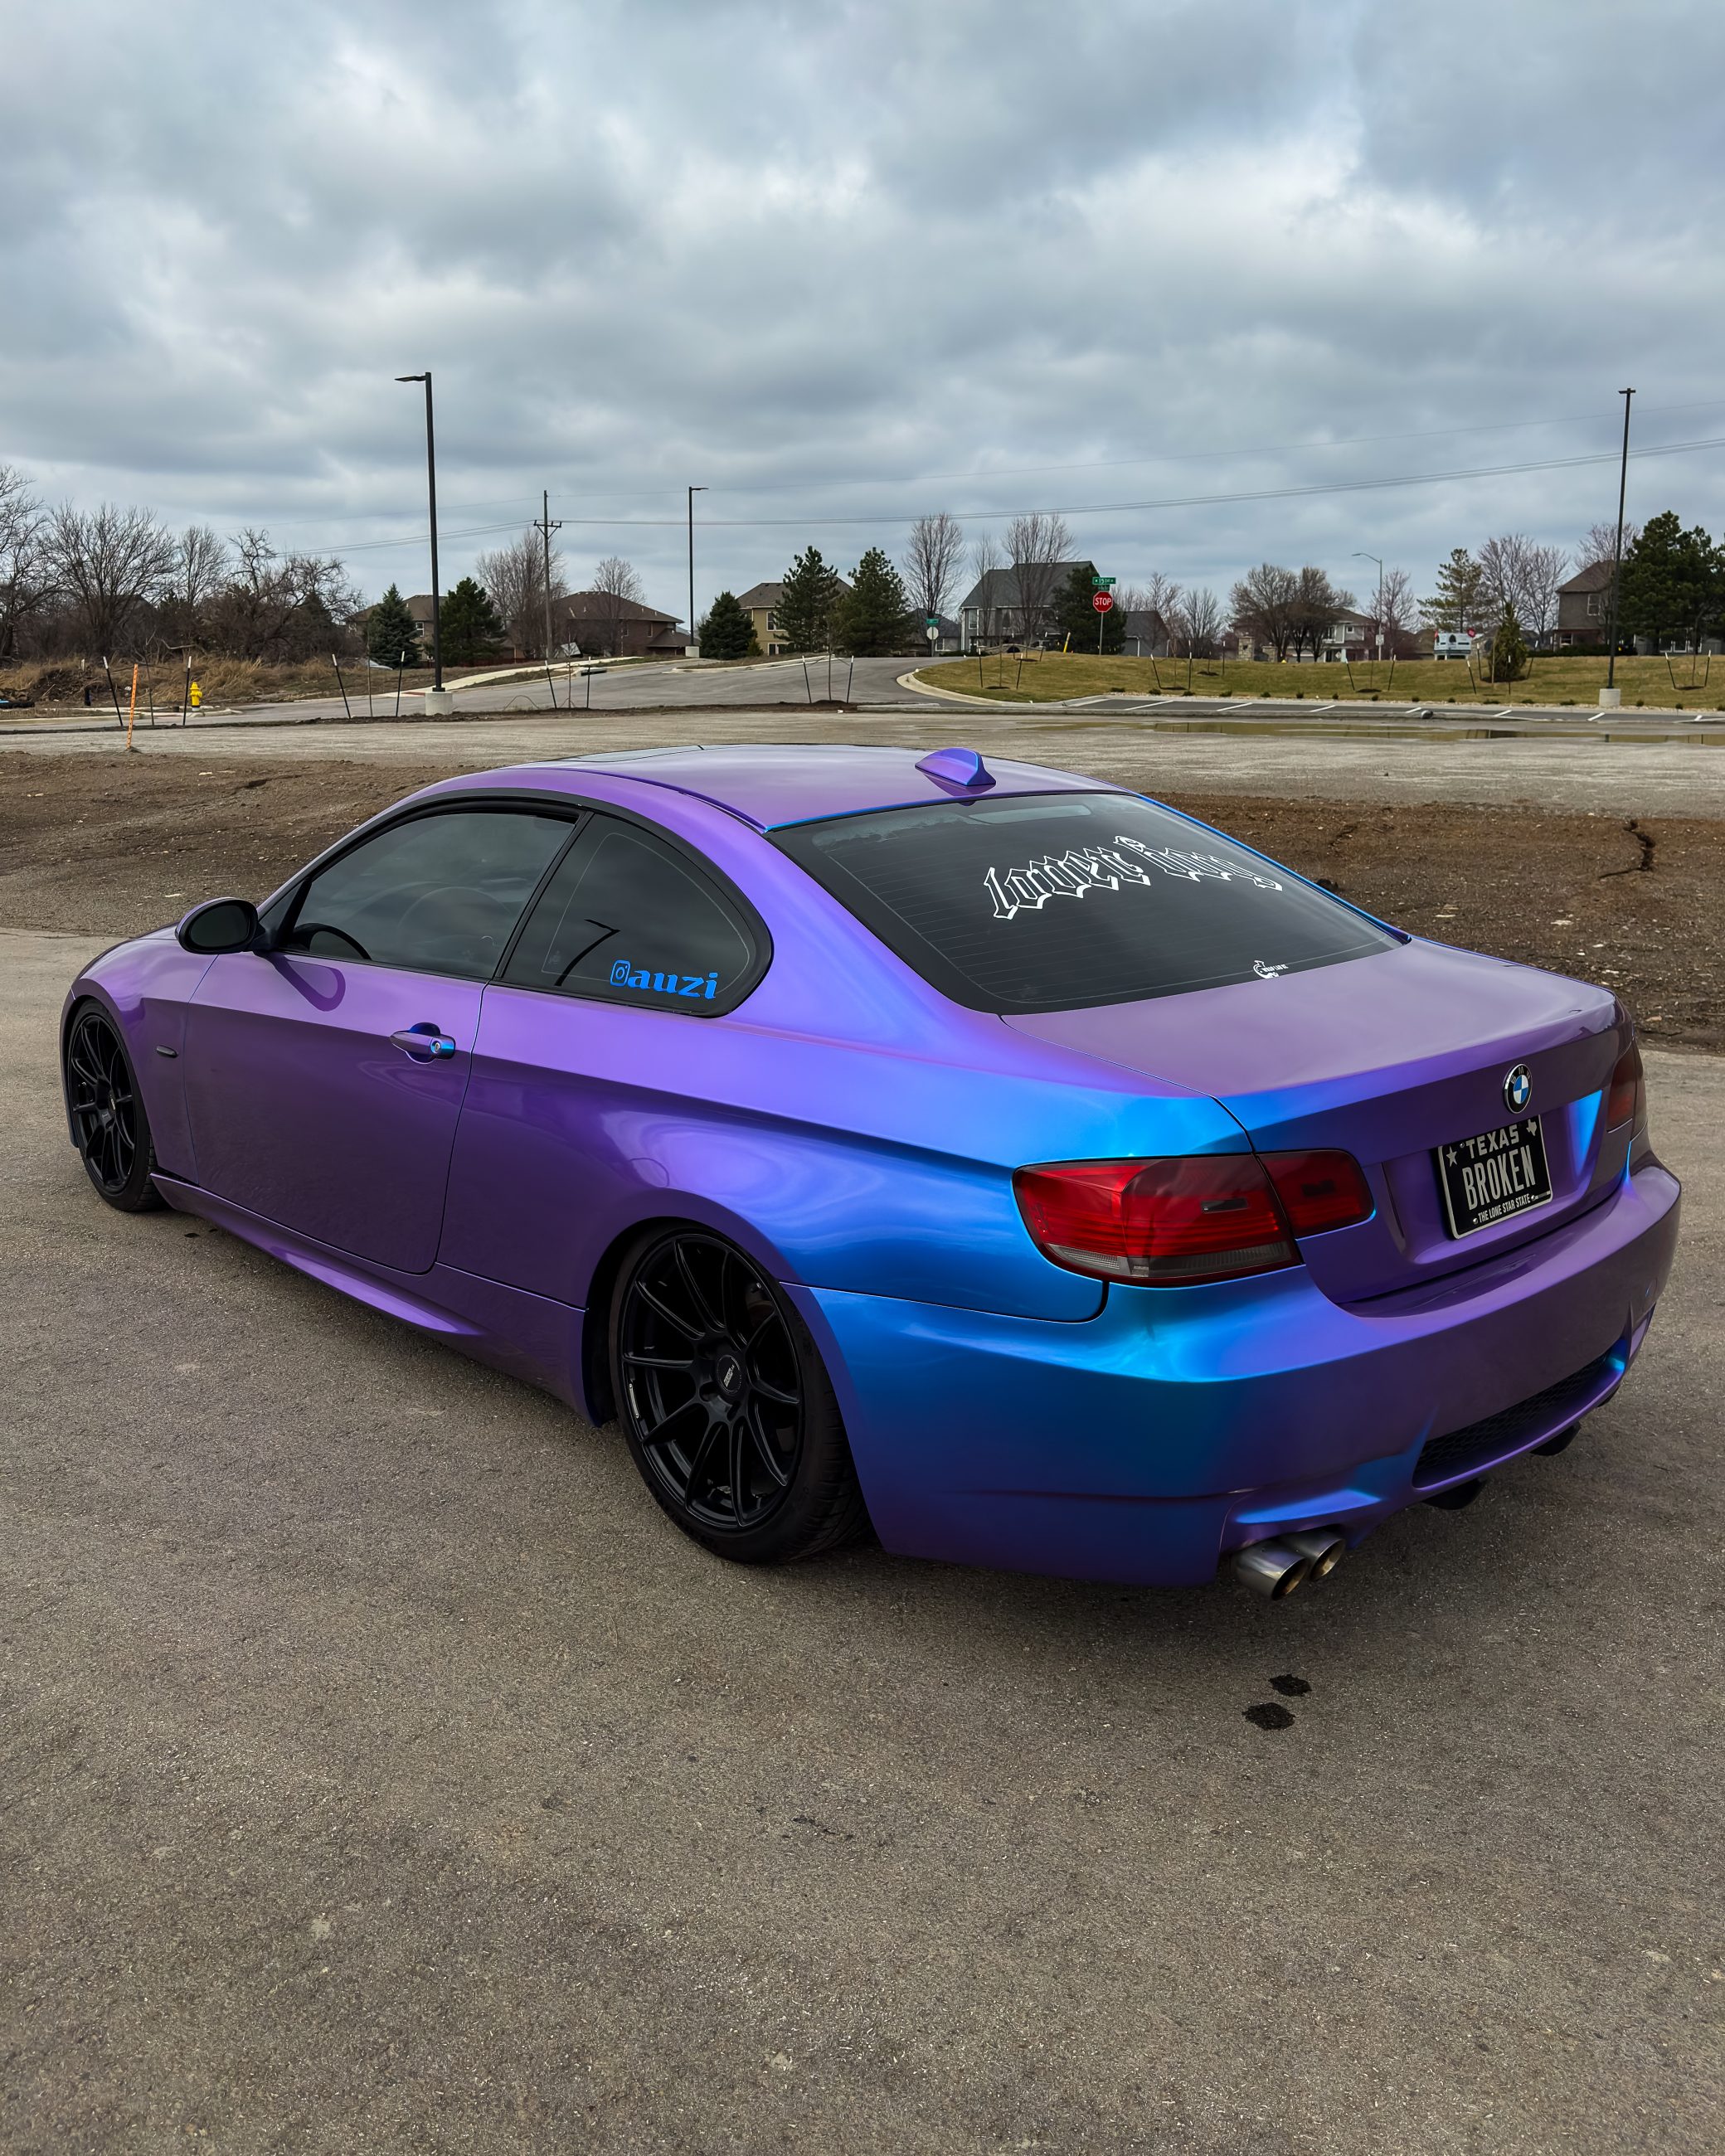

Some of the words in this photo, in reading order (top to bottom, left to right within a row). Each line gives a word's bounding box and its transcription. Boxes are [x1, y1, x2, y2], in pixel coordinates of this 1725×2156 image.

[1095, 597, 1111, 605] STOP
[628, 970, 718, 999] auzi
[1465, 1124, 1519, 1158] TEXAS
[1462, 1145, 1536, 1210] BROKEN
[1478, 1210, 1489, 1222] THE
[1489, 1205, 1503, 1219] LONE
[1502, 1199, 1516, 1213] STAR
[1515, 1193, 1531, 1208] STATE
